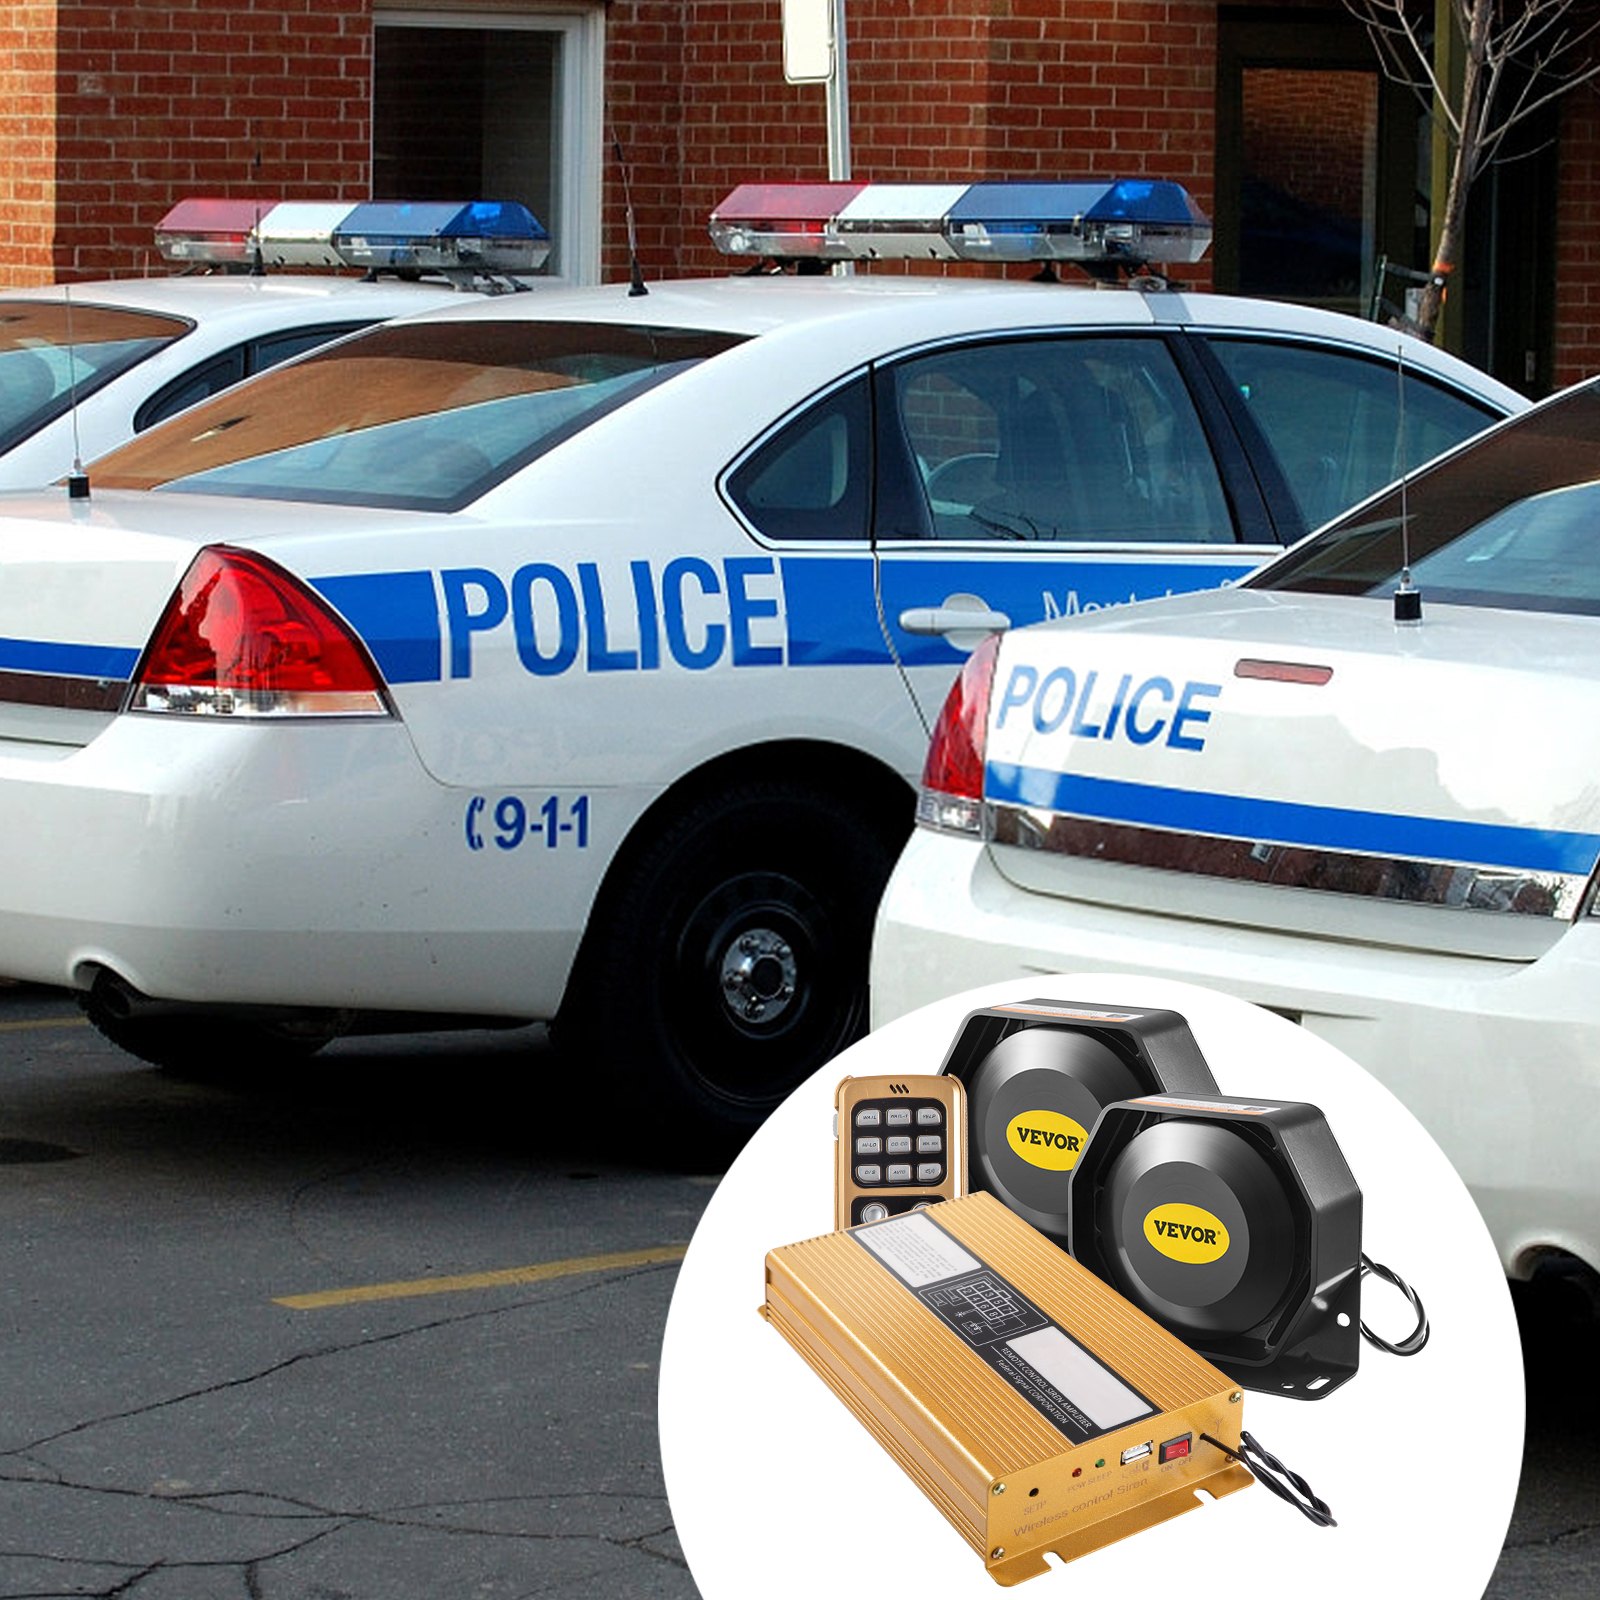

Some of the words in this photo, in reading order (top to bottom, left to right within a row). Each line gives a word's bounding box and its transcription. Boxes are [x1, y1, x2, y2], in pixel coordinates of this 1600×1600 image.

[440, 557, 783, 679] POLICE
[996, 665, 1222, 752] POLICE
[494, 796, 590, 851] 9-1-1
[1017, 1127, 1080, 1152] VEVOR
[1154, 1220, 1217, 1246] VEVOR
[1021, 1365, 1048, 1392] CONTROL
[1045, 1386, 1064, 1406] SIREN
[1014, 1508, 1068, 1537] Wireless
[1072, 1489, 1114, 1513] control
[1117, 1477, 1148, 1495] Siren
